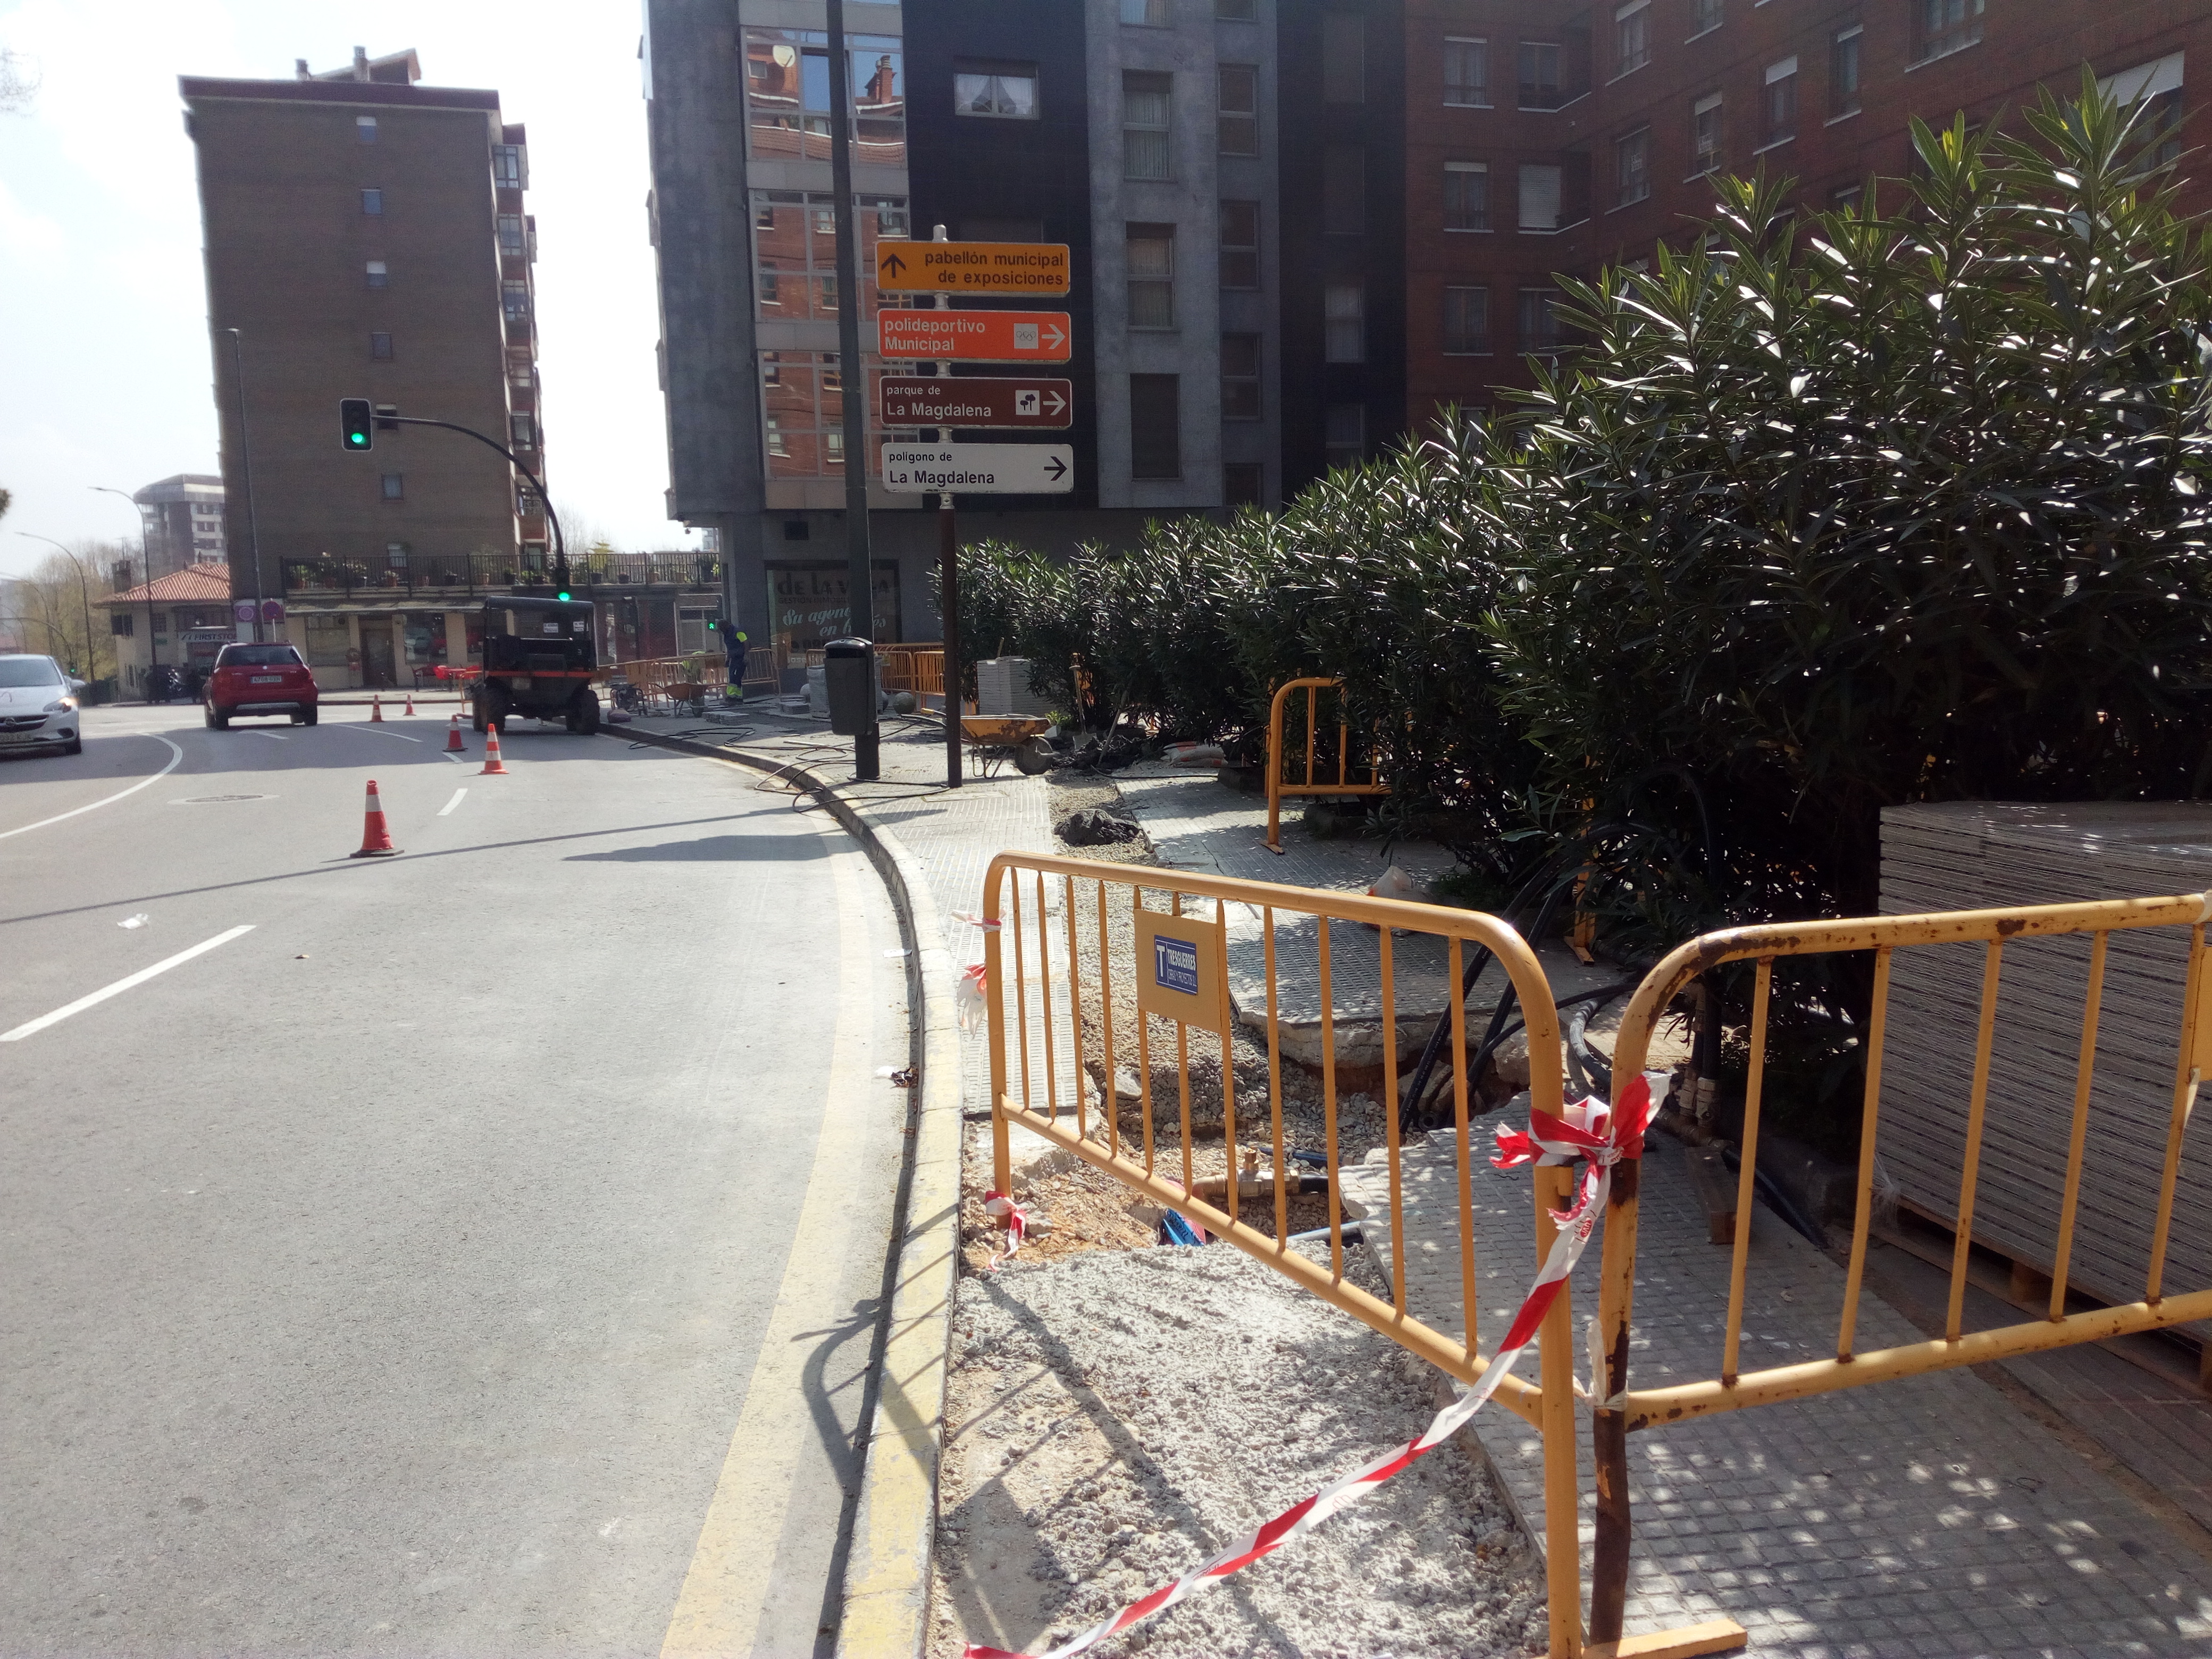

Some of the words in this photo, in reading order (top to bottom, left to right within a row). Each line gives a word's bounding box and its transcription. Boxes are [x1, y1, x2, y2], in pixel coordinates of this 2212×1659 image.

[925, 252, 987, 266] pabellón
[994, 253, 1063, 269] municipal
[938, 271, 956, 283] de
[963, 272, 1063, 287] exposiciones
[884, 319, 986, 334] polideportivo
[885, 337, 954, 354] Municipal
[886, 386, 923, 397] parque
[927, 385, 941, 395] de
[887, 402, 906, 416] La
[911, 403, 992, 420] Magdalena
[889, 452, 935, 463] polígono
[939, 452, 952, 462] de
[889, 471, 908, 483] La
[914, 470, 995, 487] Magdalena
[782, 609, 803, 626] Su
[819, 625, 837, 636] en
[1167, 949, 1196, 971] TRESGUERRES
